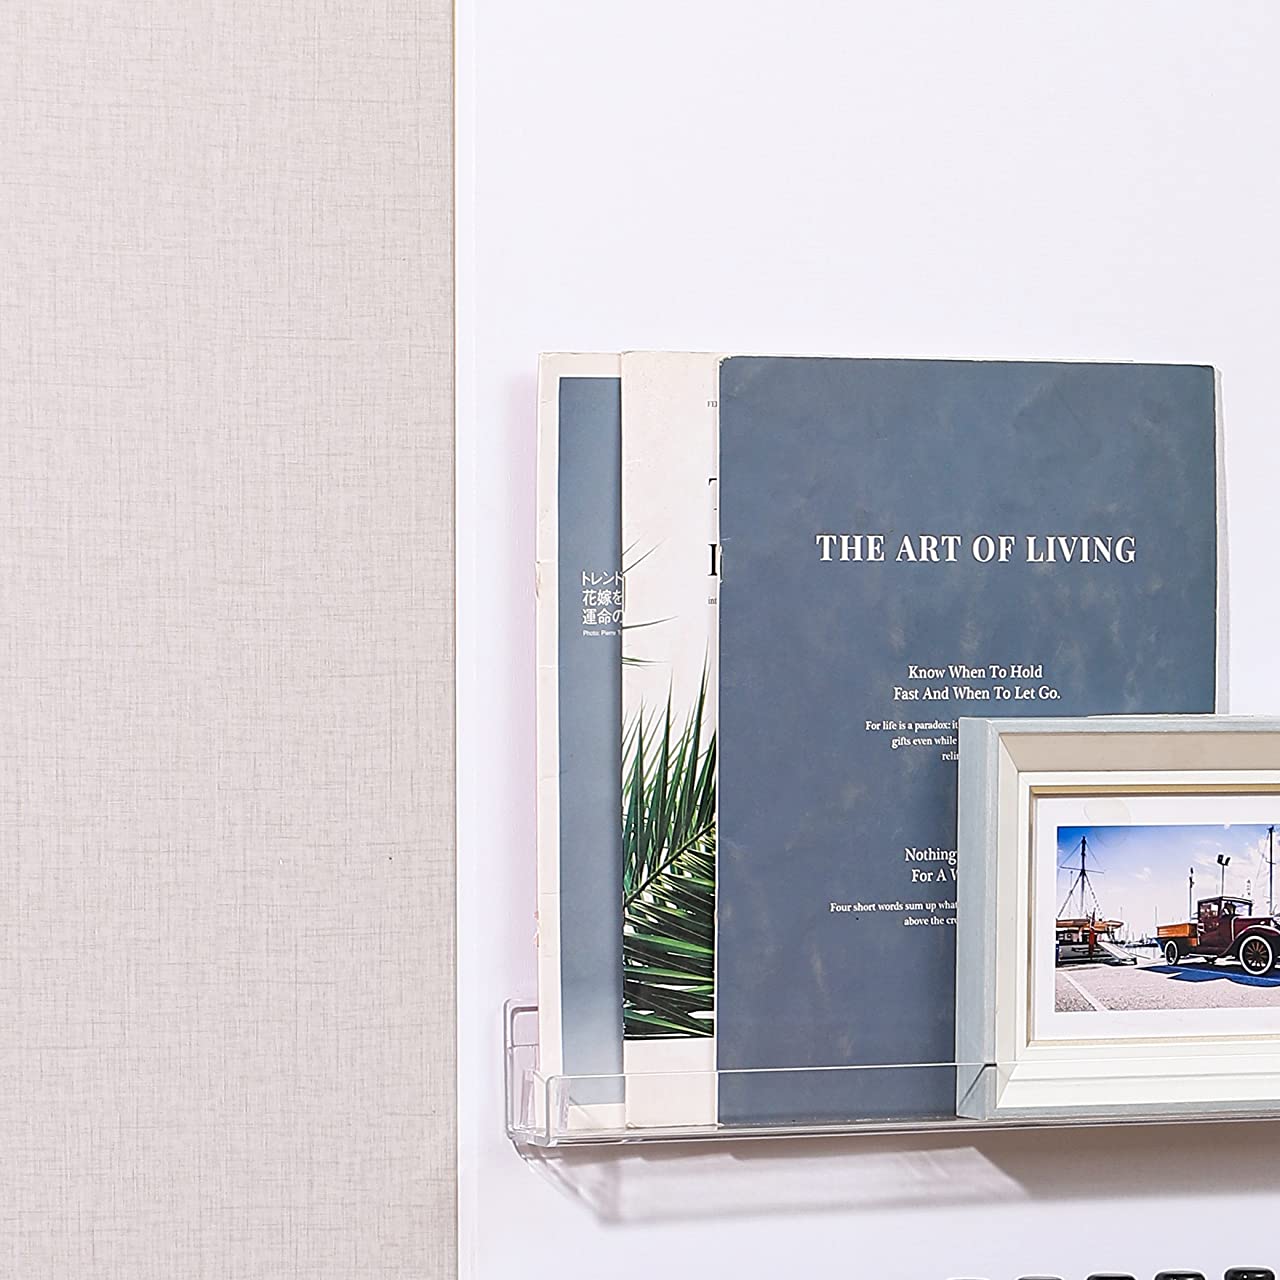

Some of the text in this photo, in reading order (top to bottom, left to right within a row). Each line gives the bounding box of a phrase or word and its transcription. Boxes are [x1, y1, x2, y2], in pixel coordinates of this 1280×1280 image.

[816, 534, 1136, 563] THE ART OF LIVING
[908, 664, 1043, 679] Know When To Hold
[893, 685, 1061, 700] Fast And When To Let Go.
[865, 720, 881, 730] For
[882, 720, 897, 730] life
[898, 720, 906, 730] is
[907, 722, 913, 730] a
[914, 720, 951, 733] paradox:
[891, 735, 957, 749] gifts even while
[904, 847, 957, 865] Nothing
[911, 868, 933, 882] For
[936, 868, 947, 882] A
[830, 900, 958, 913] Four short words sum up what
[903, 916, 929, 926] above
[930, 916, 945, 926] the
